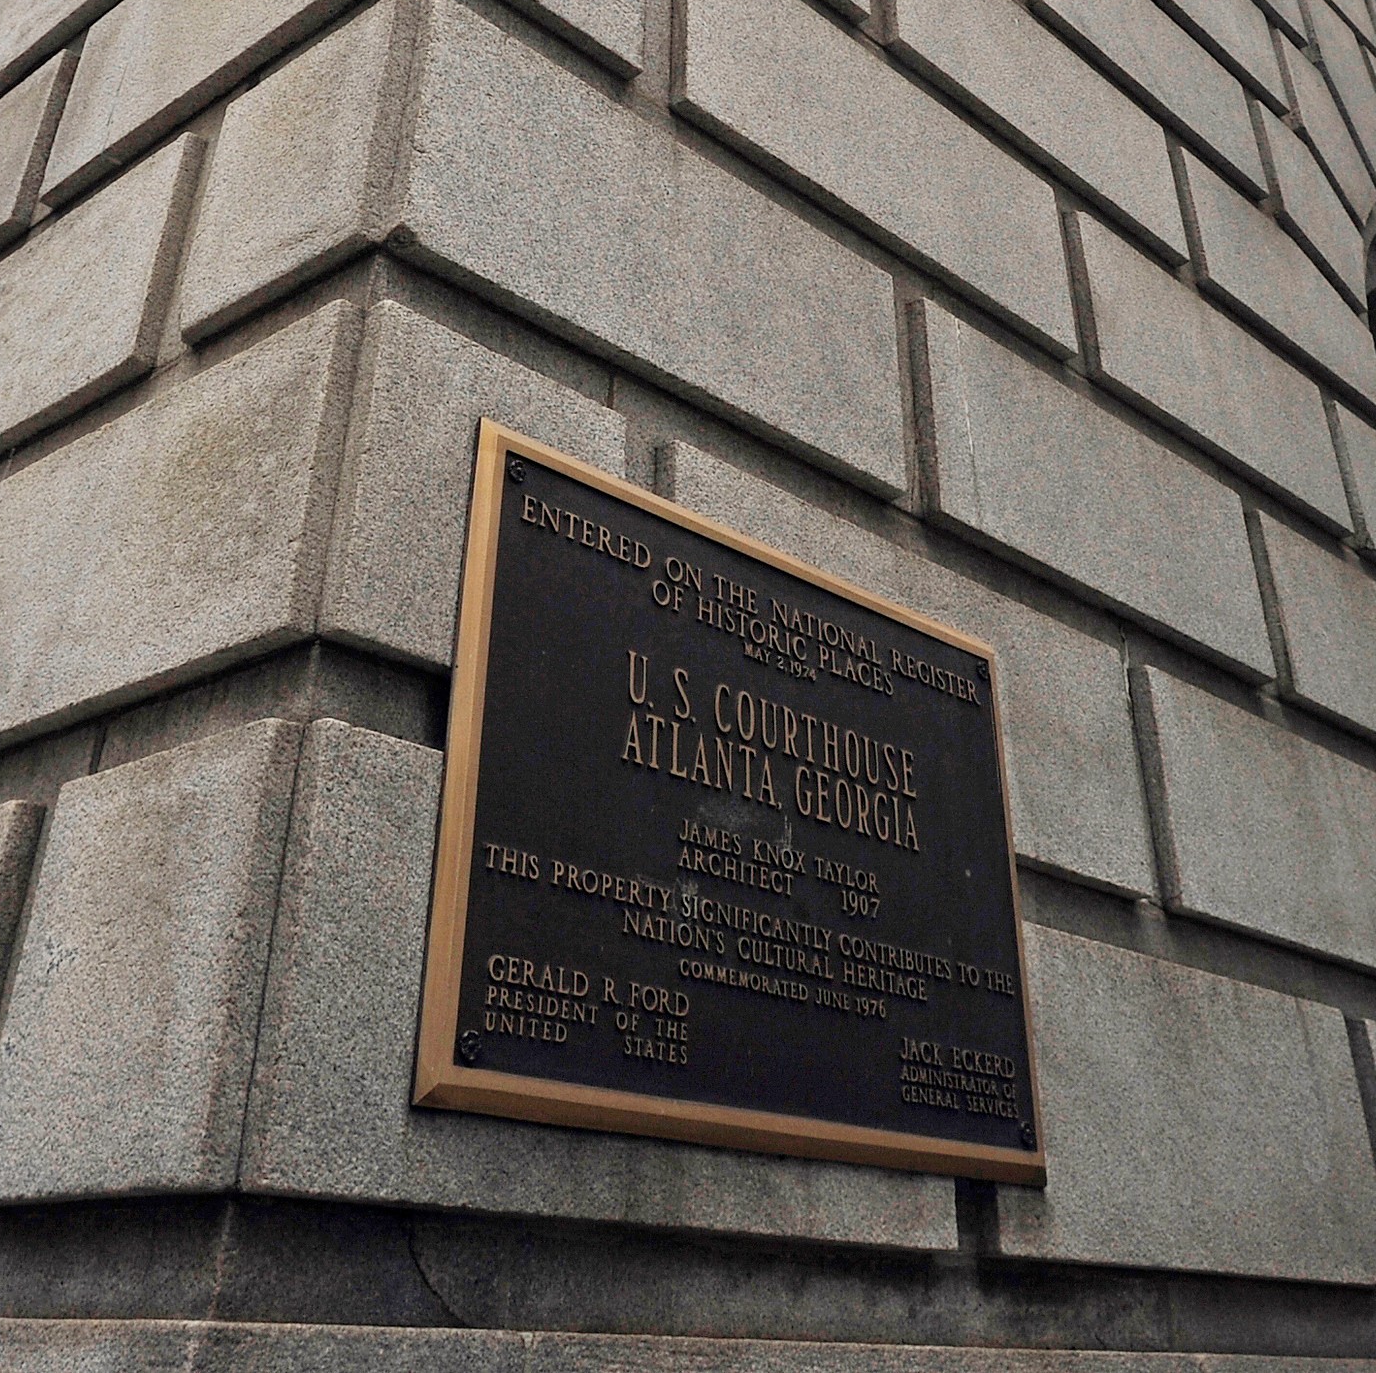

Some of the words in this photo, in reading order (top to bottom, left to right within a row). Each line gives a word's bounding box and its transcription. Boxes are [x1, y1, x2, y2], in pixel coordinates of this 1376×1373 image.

[521, 494, 651, 568] ENTERED
[665, 557, 702, 592] ON
[713, 574, 758, 614] THE
[770, 599, 882, 665] NATIONAL
[891, 648, 981, 706] REGISTER
[652, 580, 684, 612] OF
[697, 596, 807, 661] HISTORIC
[818, 644, 894, 696] PLACES
[744, 641, 771, 664] MAY
[628, 650, 654, 708] U.
[674, 668, 696, 723] S.
[714, 684, 917, 798] COURTHOUSE
[621, 711, 782, 810] ATLANTA,
[795, 766, 920, 852] GEORGIA
[678, 846, 794, 896] ARCHITECT
[841, 890, 880, 918] 1907
[679, 818, 741, 855] JAMES
[752, 838, 806, 874] KNOX
[814, 856, 879, 893] TAYLOR
[484, 843, 540, 880] THIS
[551, 859, 671, 912] PROPERTY
[682, 893, 832, 951] SIGNIFICANTLY
[839, 934, 952, 980] CONTRIBUTES
[957, 962, 980, 986] TO
[985, 969, 1015, 995] THE
[488, 954, 589, 997] GERALD
[629, 982, 689, 1017] FORD
[624, 909, 724, 954] NATION'S
[737, 937, 834, 979] CULTURAL
[843, 961, 928, 1002] HERITAGE
[679, 958, 809, 1001] COMMEMORATED
[815, 987, 850, 1010] JUNE
[855, 997, 886, 1018] 1976
[485, 985, 599, 1025] PRESIDENT
[616, 1011, 639, 1031] OF
[655, 1018, 688, 1041] THE
[485, 1011, 568, 1043] UNITED
[624, 1035, 687, 1064] STATES
[900, 1036, 943, 1066] JACK
[951, 1047, 1015, 1078] ECKERD
[900, 1065, 999, 1096] ADMINISTRATOR
[902, 1085, 960, 1109] GENERAL
[966, 1095, 1019, 1118] SERVICES
